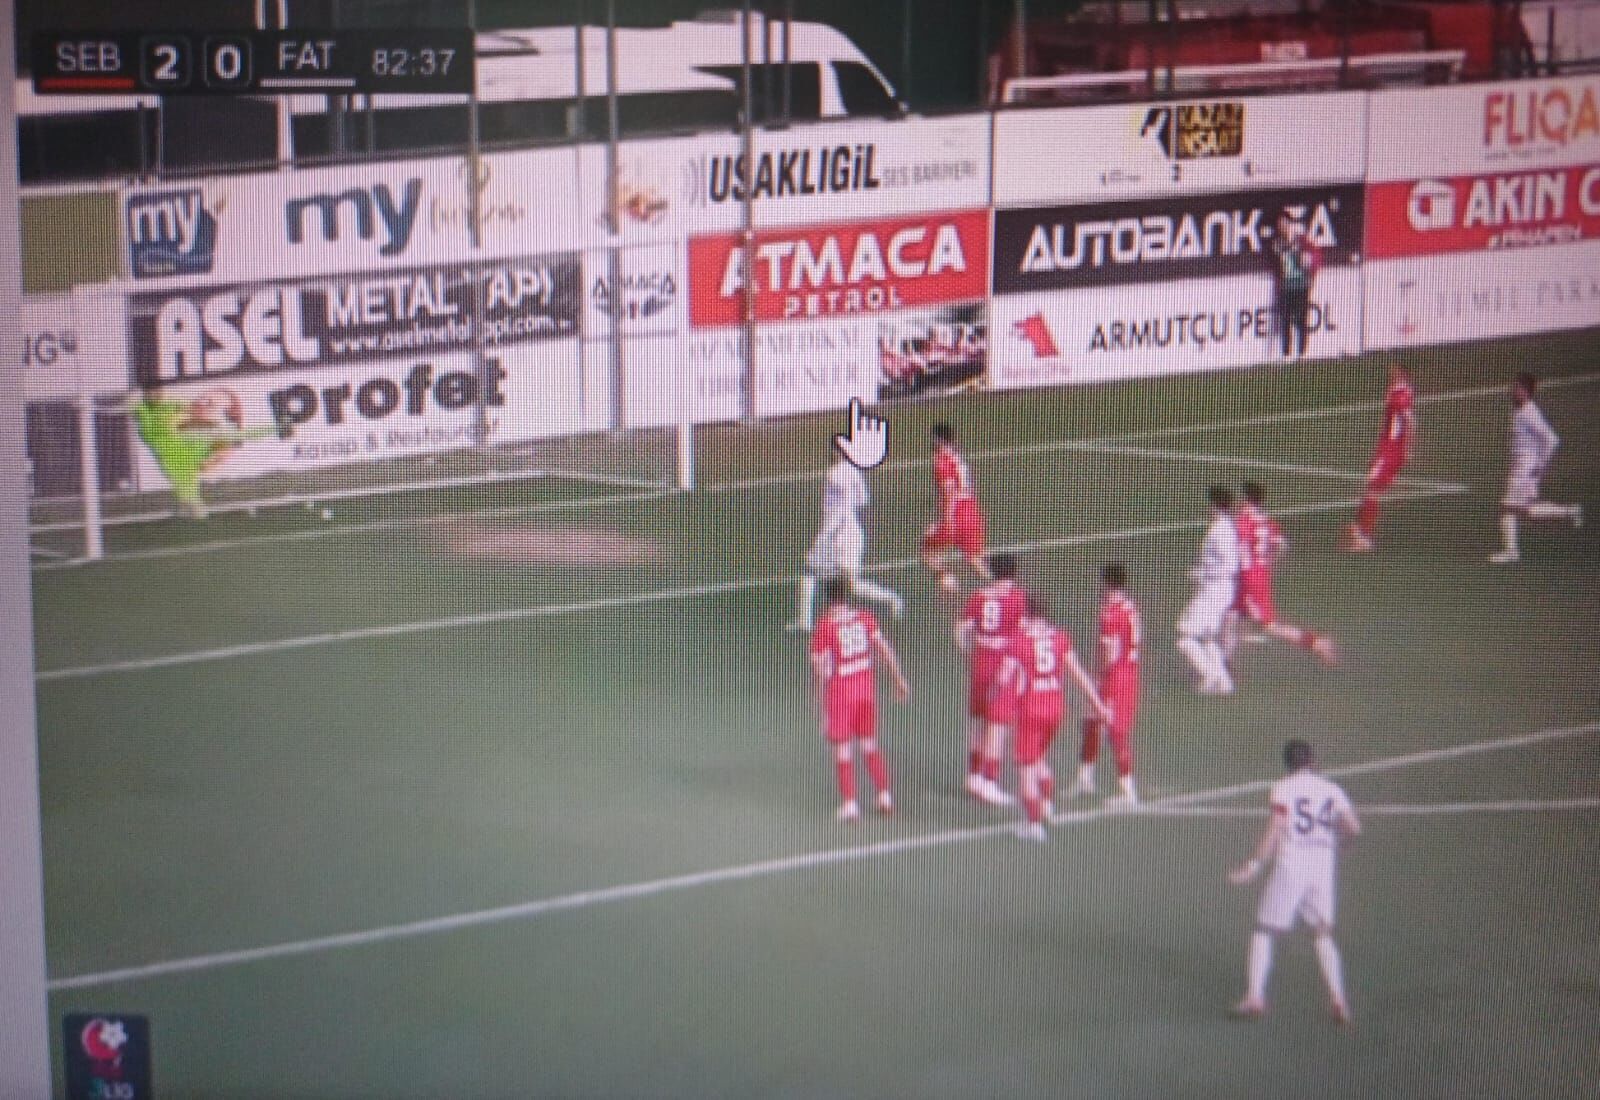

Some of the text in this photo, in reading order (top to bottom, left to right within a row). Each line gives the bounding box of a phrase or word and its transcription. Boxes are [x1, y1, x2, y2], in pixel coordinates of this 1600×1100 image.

[57, 41, 456, 80] SEB 2 0 FAT 82:37
[131, 194, 200, 253] my
[286, 178, 423, 256] my
[1463, 171, 1566, 229] AKIN
[719, 223, 967, 298] ATMACA
[156, 286, 320, 380] ASEL
[326, 272, 458, 328] METAL
[784, 285, 902, 318] PETROL
[1089, 303, 1337, 352] ARMUTÇU PEOL
[270, 354, 507, 440] profet
[1295, 797, 1341, 834] 54
